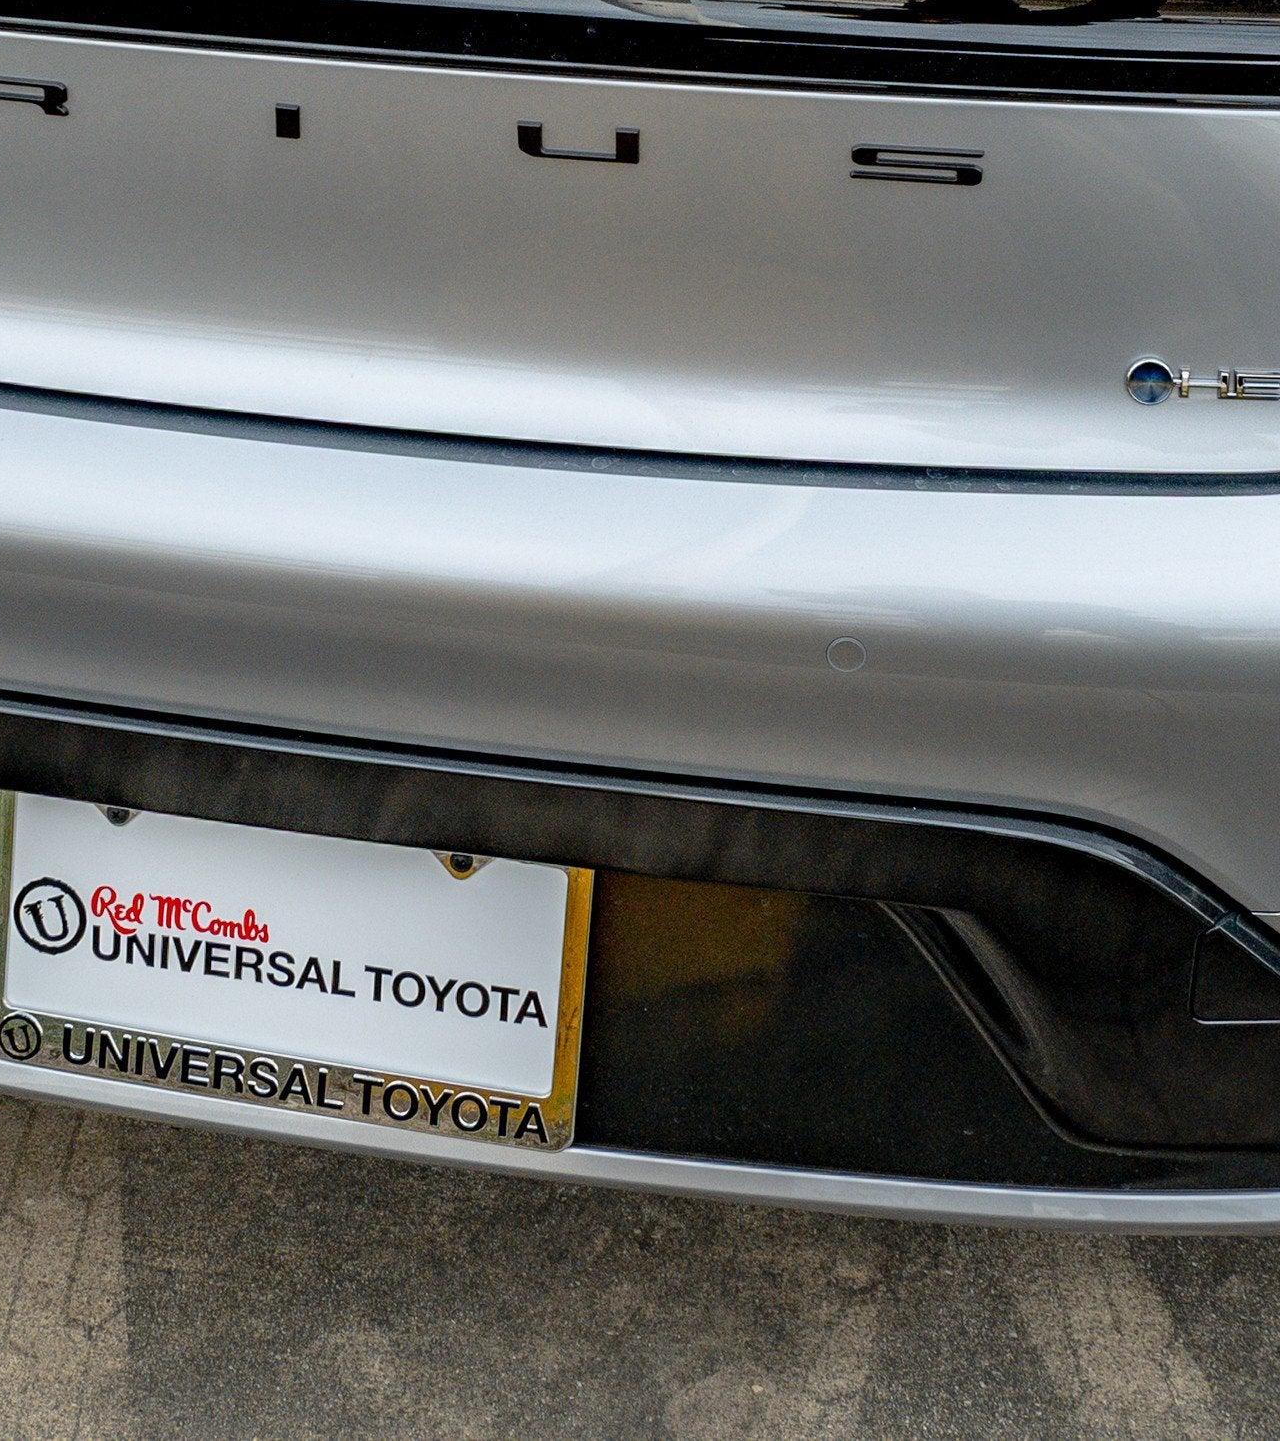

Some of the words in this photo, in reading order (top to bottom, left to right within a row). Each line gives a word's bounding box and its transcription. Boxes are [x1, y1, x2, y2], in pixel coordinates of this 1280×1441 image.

[91, 885, 145, 935] Red
[149, 893, 269, 943] McCombs
[92, 924, 356, 998] UNIVERSAL
[364, 964, 548, 1028] TOYOTA
[62, 1023, 344, 1110] UNIVERSAL
[352, 1073, 550, 1144] TOYOTA
